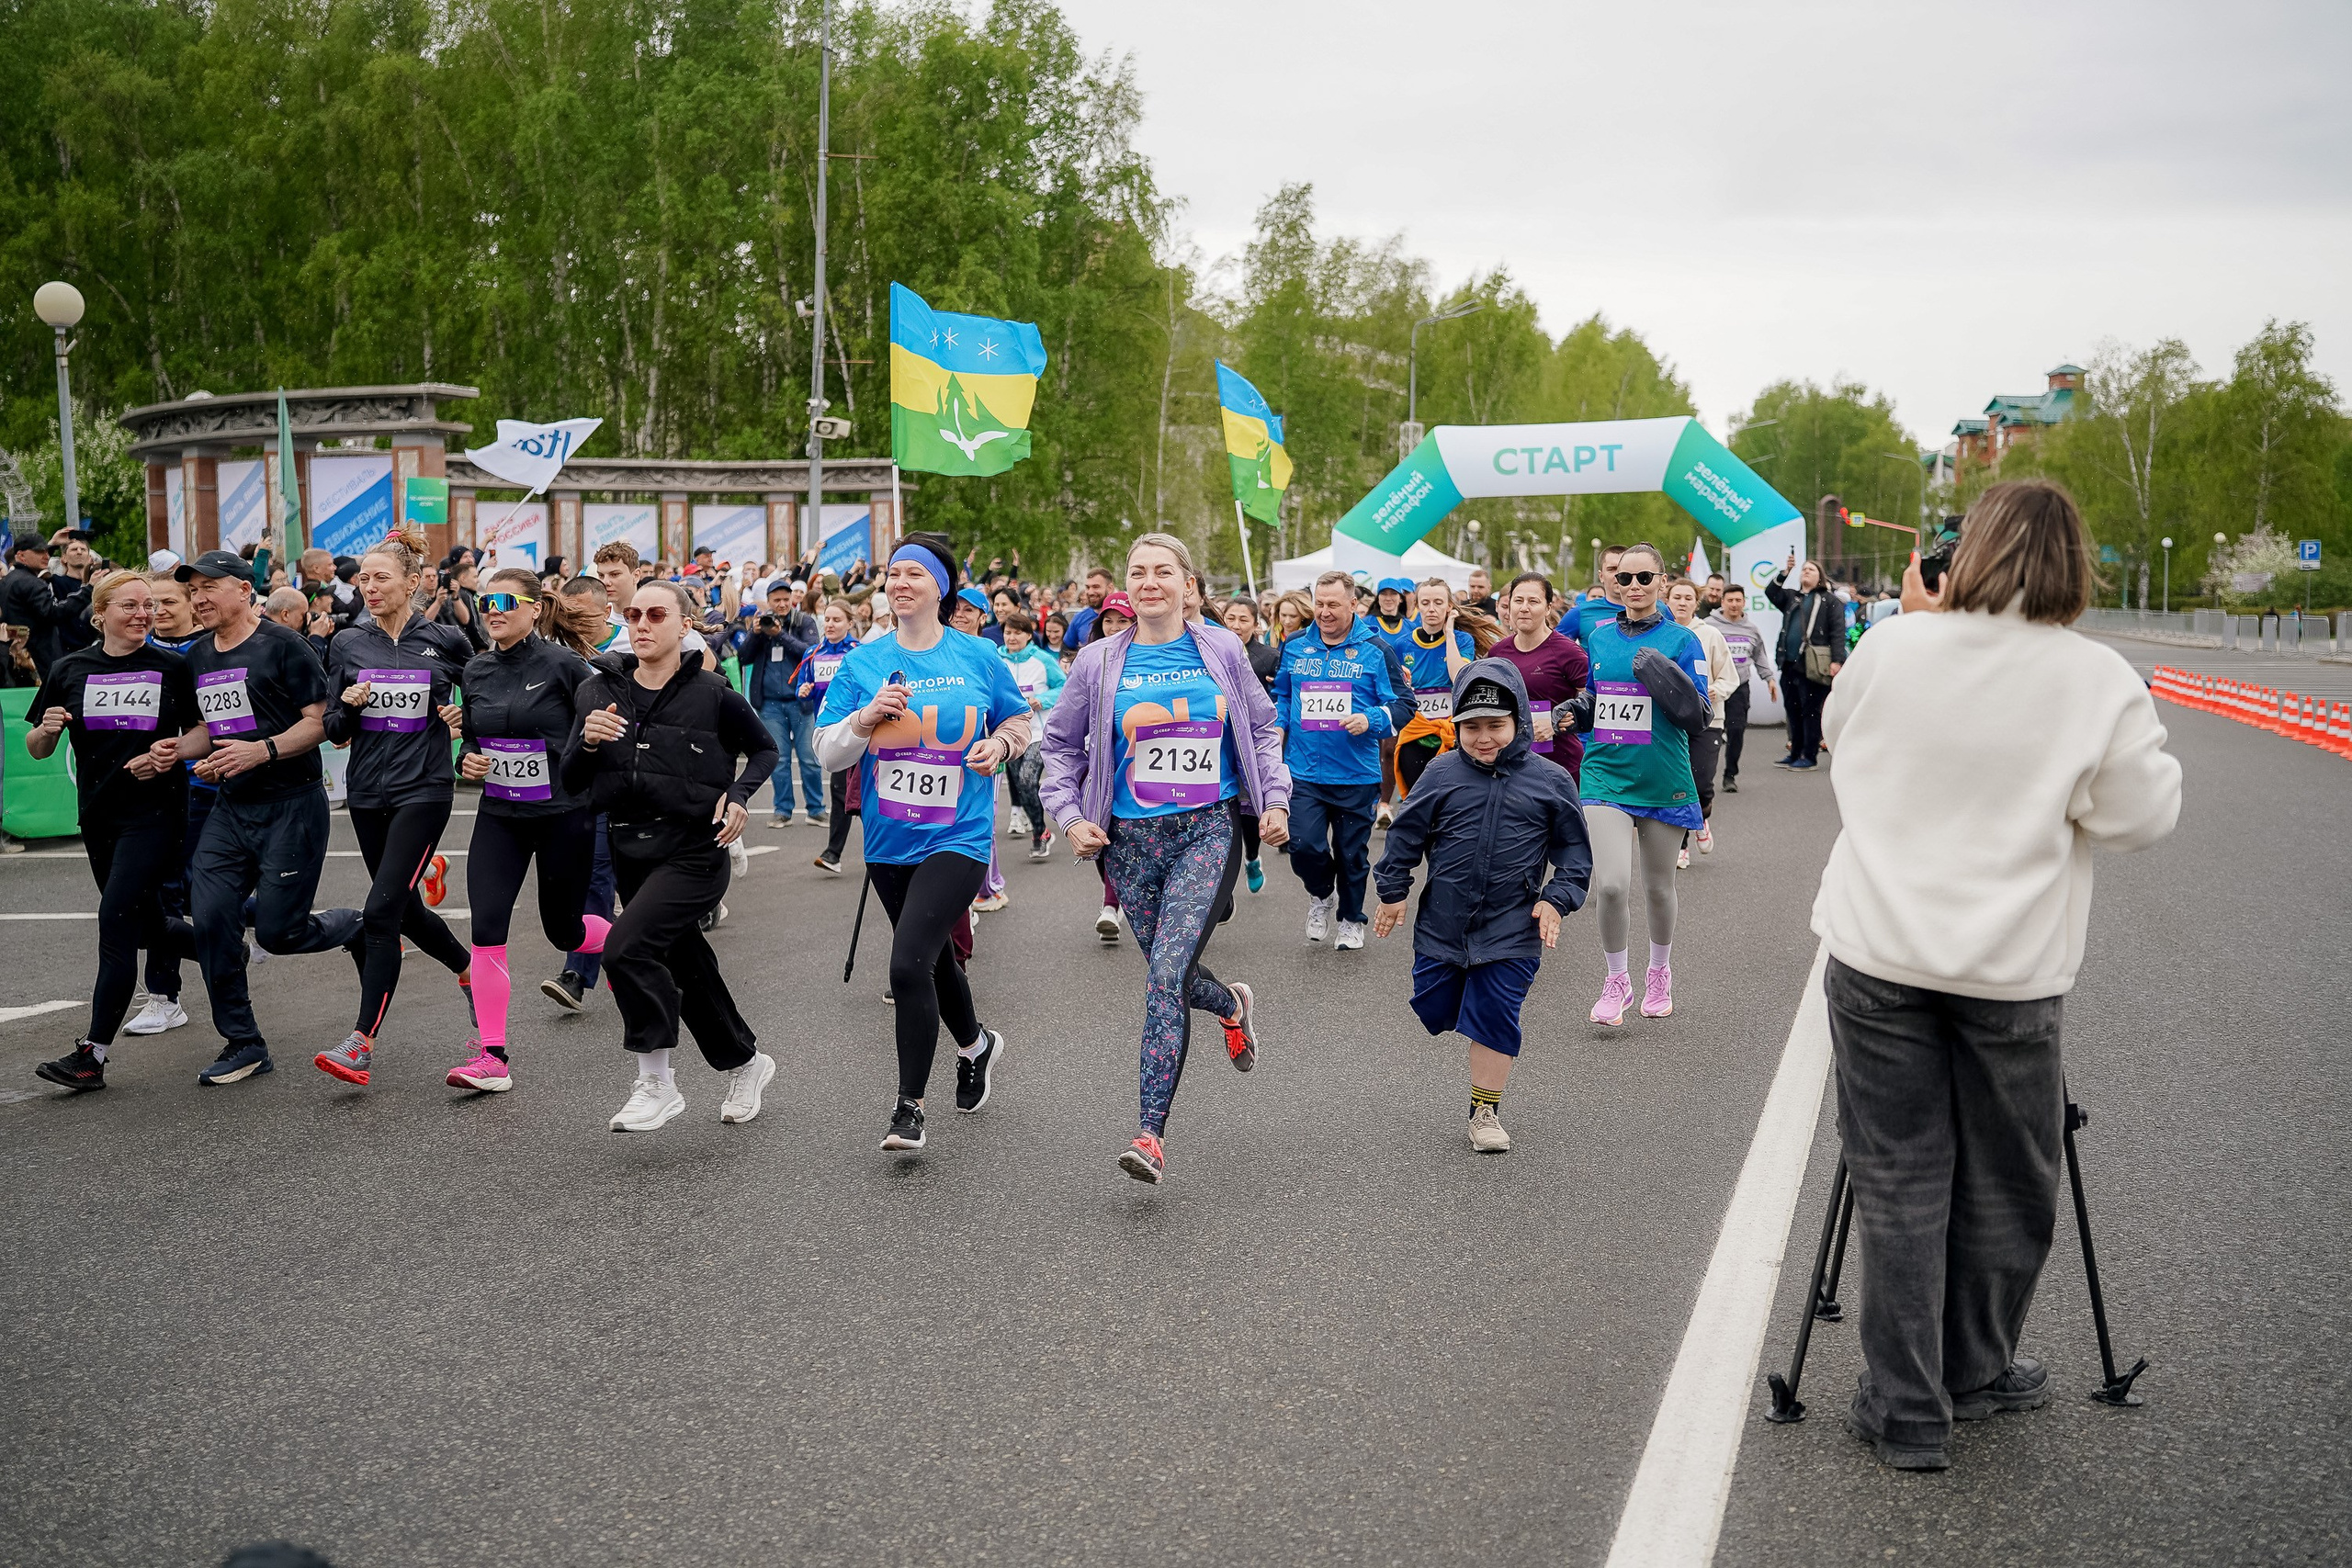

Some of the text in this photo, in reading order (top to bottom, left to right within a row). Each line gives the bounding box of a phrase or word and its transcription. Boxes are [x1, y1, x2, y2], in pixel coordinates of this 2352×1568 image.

[1492, 445, 1623, 476] СТАРТ
[319, 468, 377, 513] ФЕСТИВАЛЬ
[1372, 469, 1425, 524] зелёный
[1683, 470, 1742, 523] марафон
[1693, 460, 1754, 513] зелёный
[1380, 481, 1433, 533] марафон
[323, 496, 389, 551] ДВИЖЕНИЕ
[334, 517, 390, 557] РВЫХ
[2305, 544, 2317, 558] P
[819, 666, 838, 676] 200
[906, 676, 965, 689] ЮГОРИЯ
[95, 690, 152, 707] 2144
[203, 690, 242, 713] 2283
[368, 692, 421, 709] 2039
[1306, 698, 1344, 712] 2146
[1417, 698, 1449, 712] 2264
[1599, 702, 1644, 721] 2147
[492, 758, 540, 778] 2128
[1148, 748, 1213, 772] 2134
[890, 769, 947, 795] 2181
